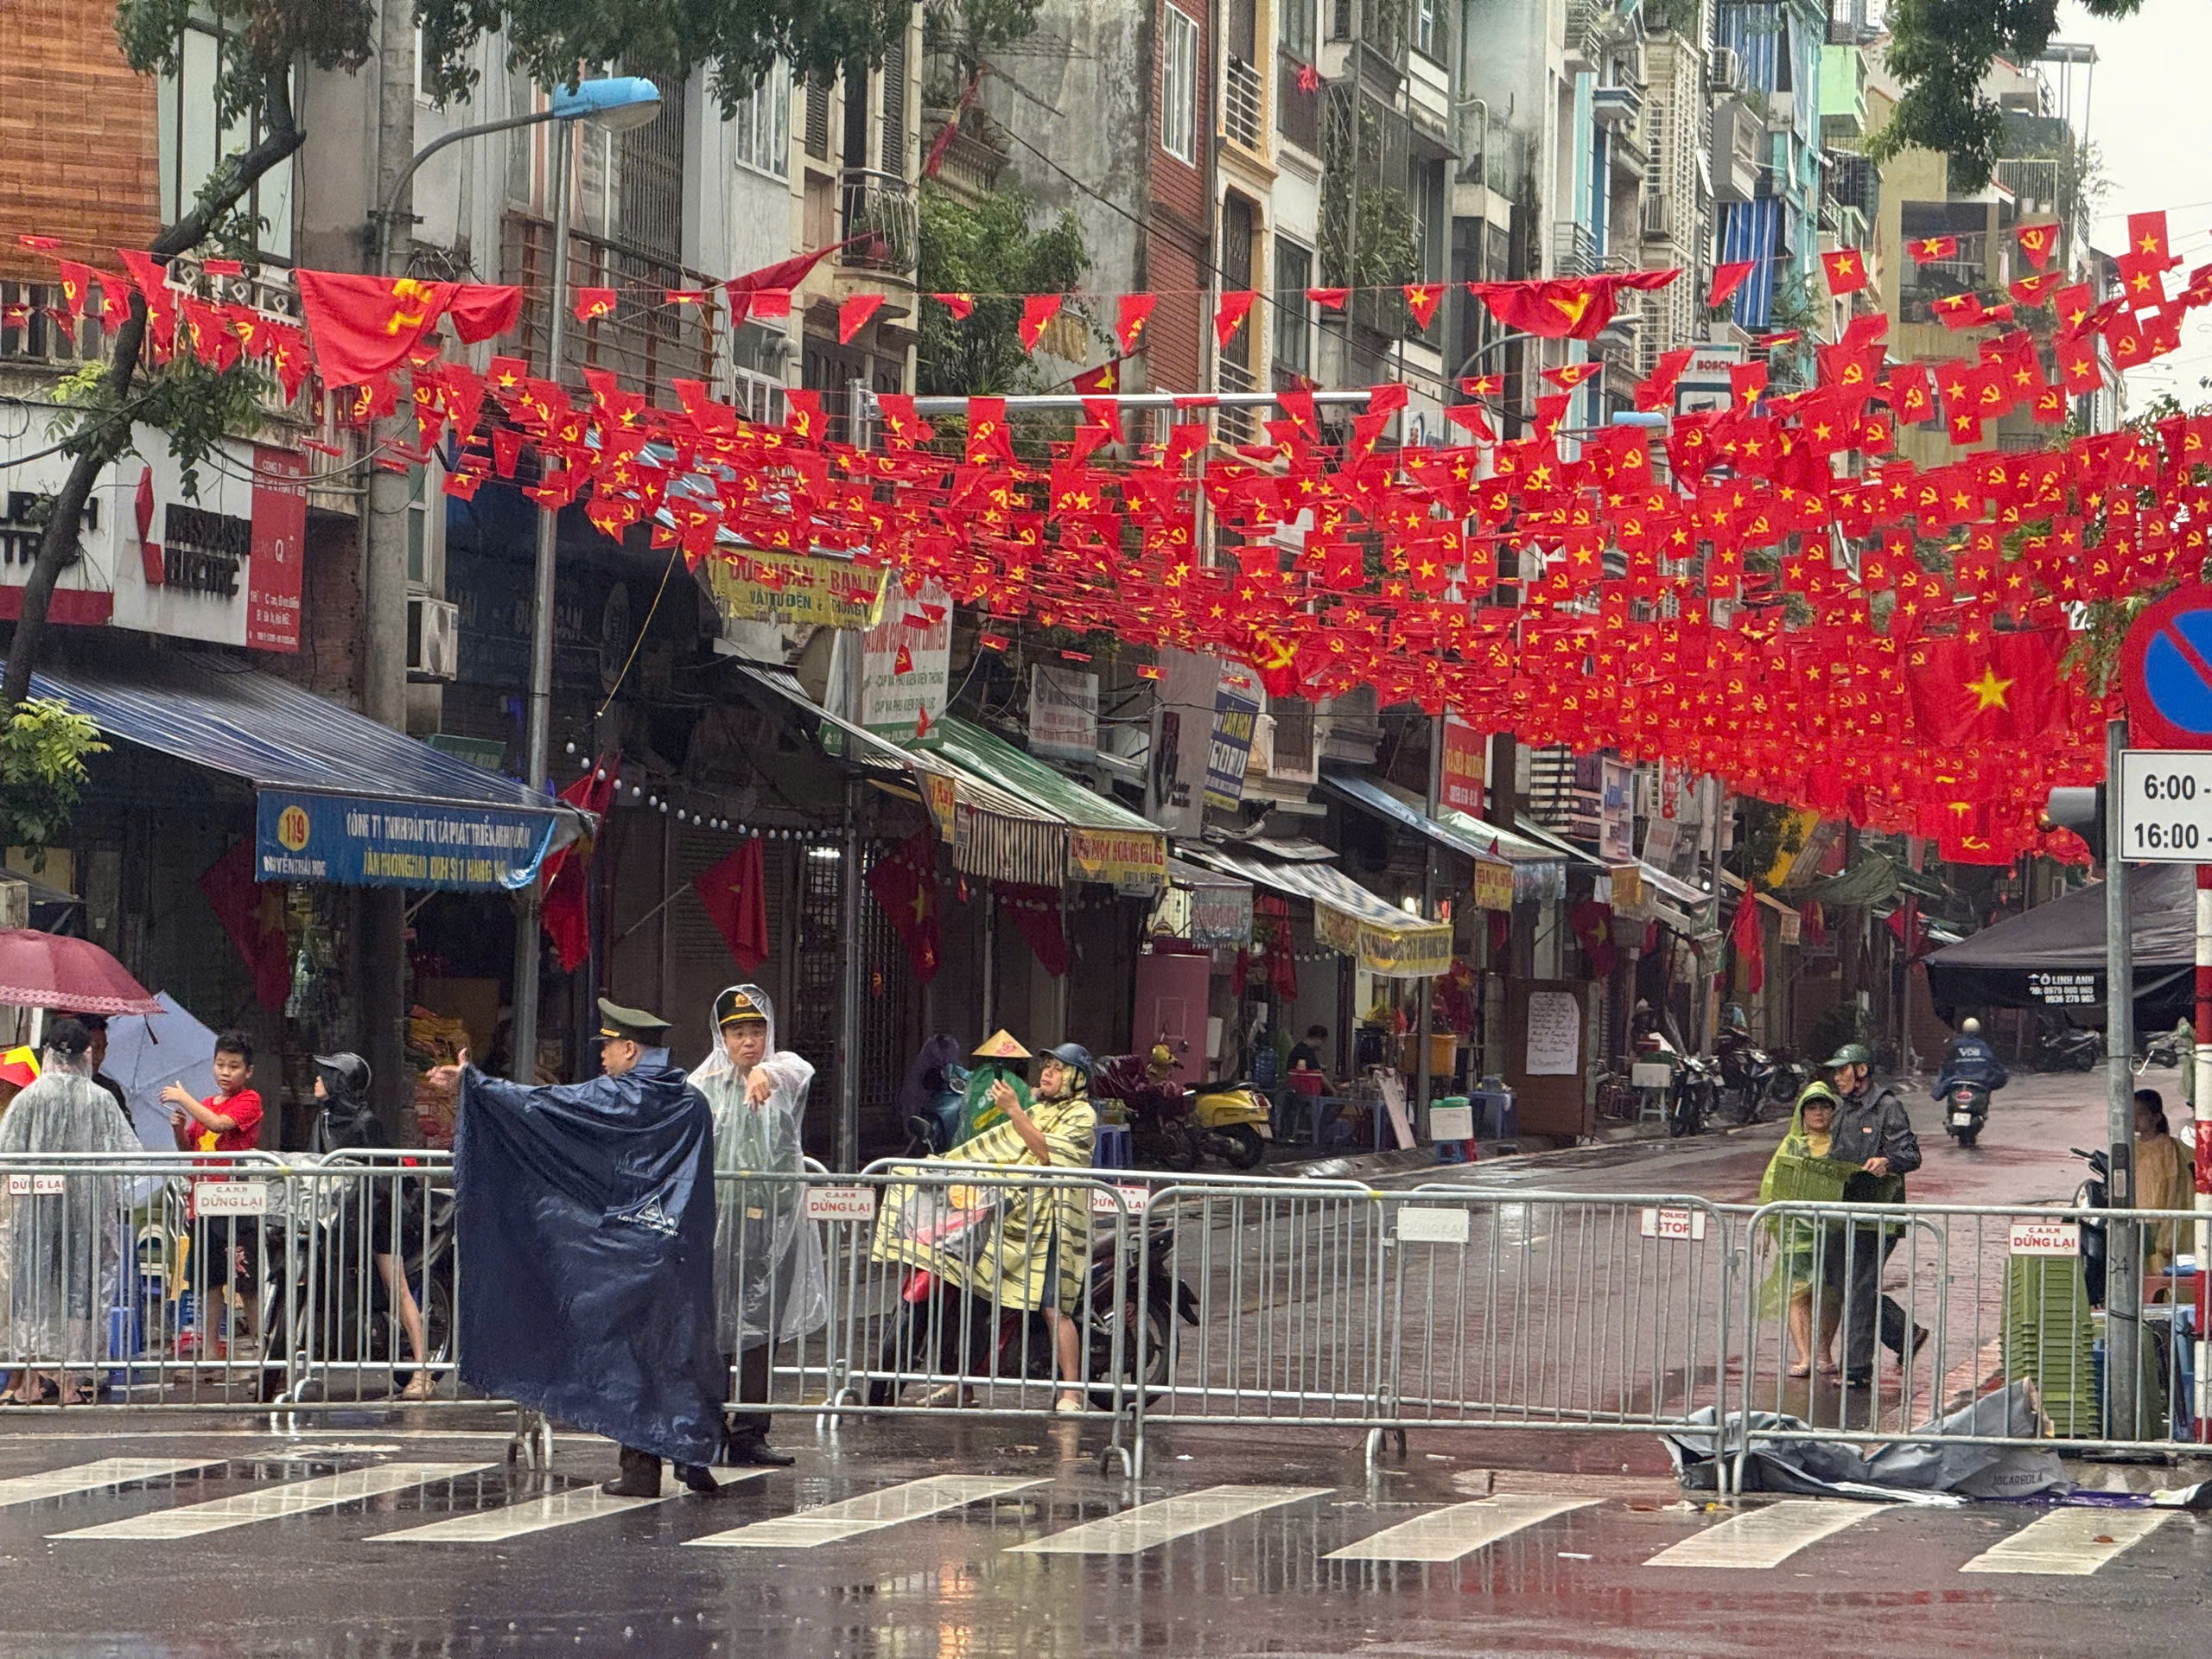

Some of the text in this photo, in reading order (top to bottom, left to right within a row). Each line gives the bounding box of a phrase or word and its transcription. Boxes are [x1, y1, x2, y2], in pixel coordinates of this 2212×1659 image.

[2145, 774, 2196, 800] 6:00
[2135, 823, 2199, 849] 16:00
[2052, 976, 2073, 985] LINH
[2075, 976, 2094, 985] ANH
[12, 1178, 43, 1190] DỪG
[241, 1197, 263, 1209] LẠI
[1092, 1195, 1116, 1207] DỪN
[849, 1202, 870, 1214] LẠI
[2013, 1234, 2075, 1249] DỪNG LẠI
